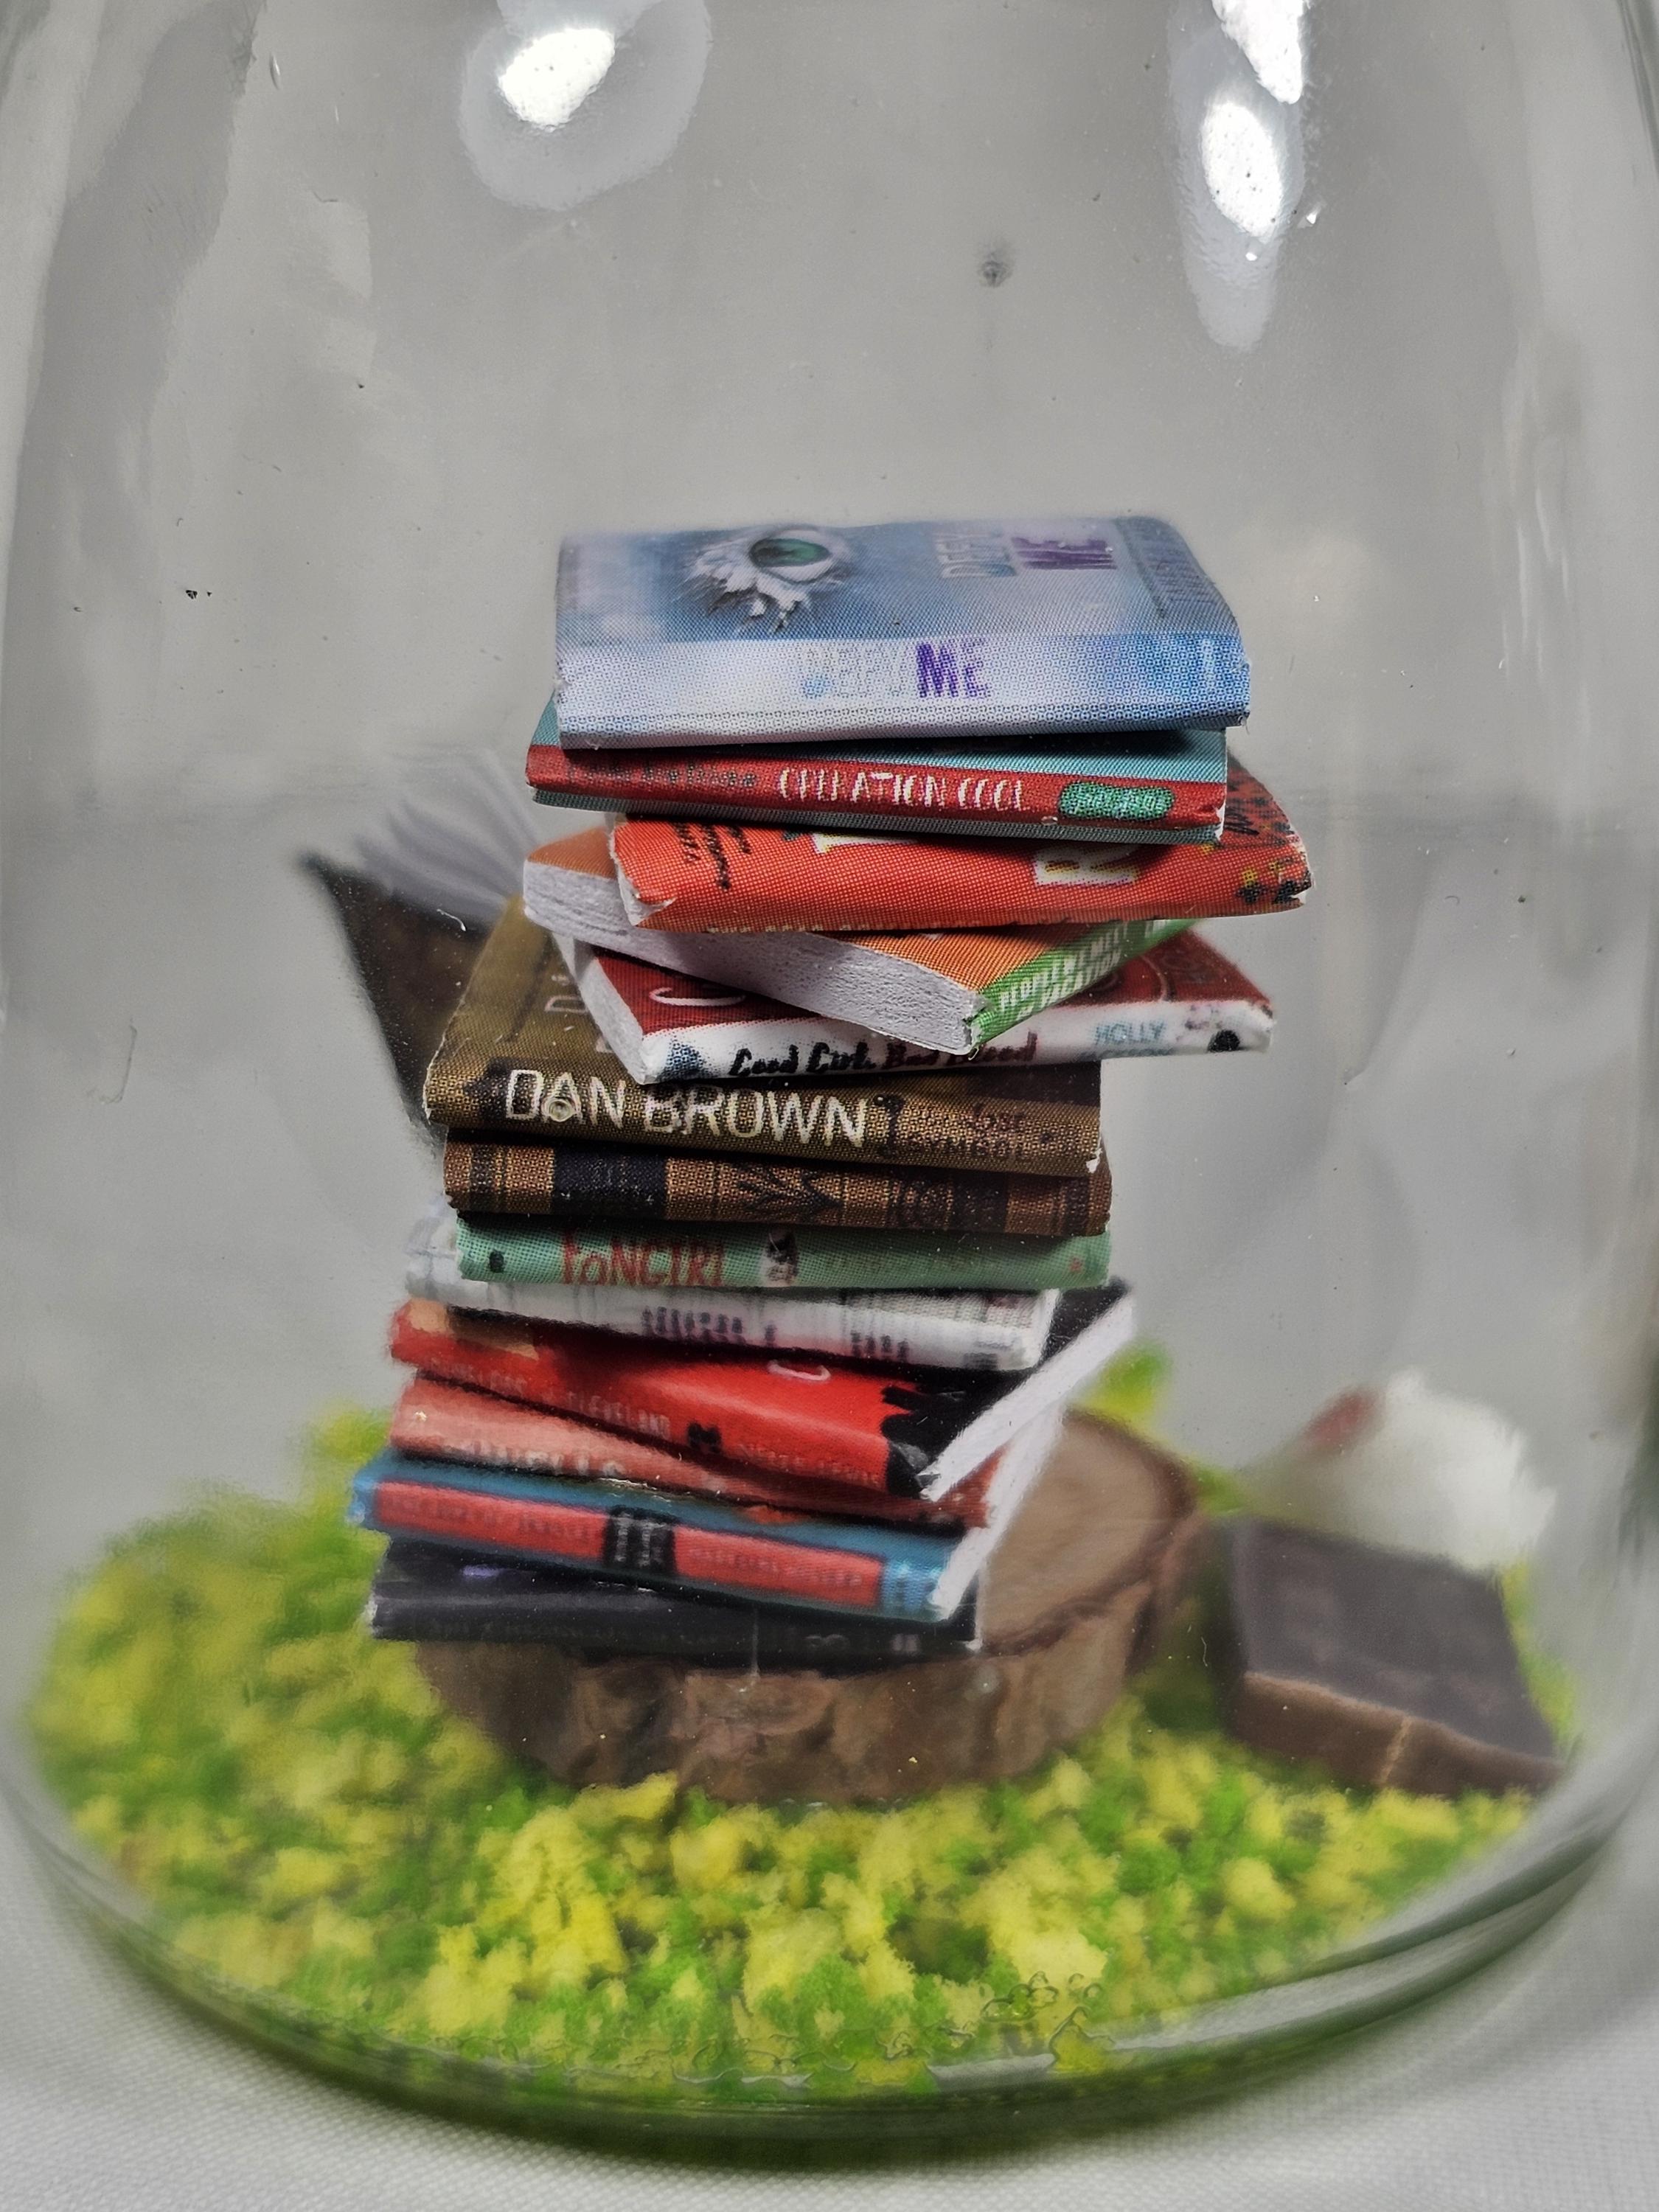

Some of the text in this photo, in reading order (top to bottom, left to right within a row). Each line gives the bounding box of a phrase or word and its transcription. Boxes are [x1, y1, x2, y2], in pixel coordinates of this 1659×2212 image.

[915, 636, 991, 700] ME
[776, 767, 948, 808] OPERATION
[956, 776, 1032, 813] COOL
[1096, 1020, 1168, 1047] HOLLY
[505, 1069, 867, 1148] DAN BROWN
